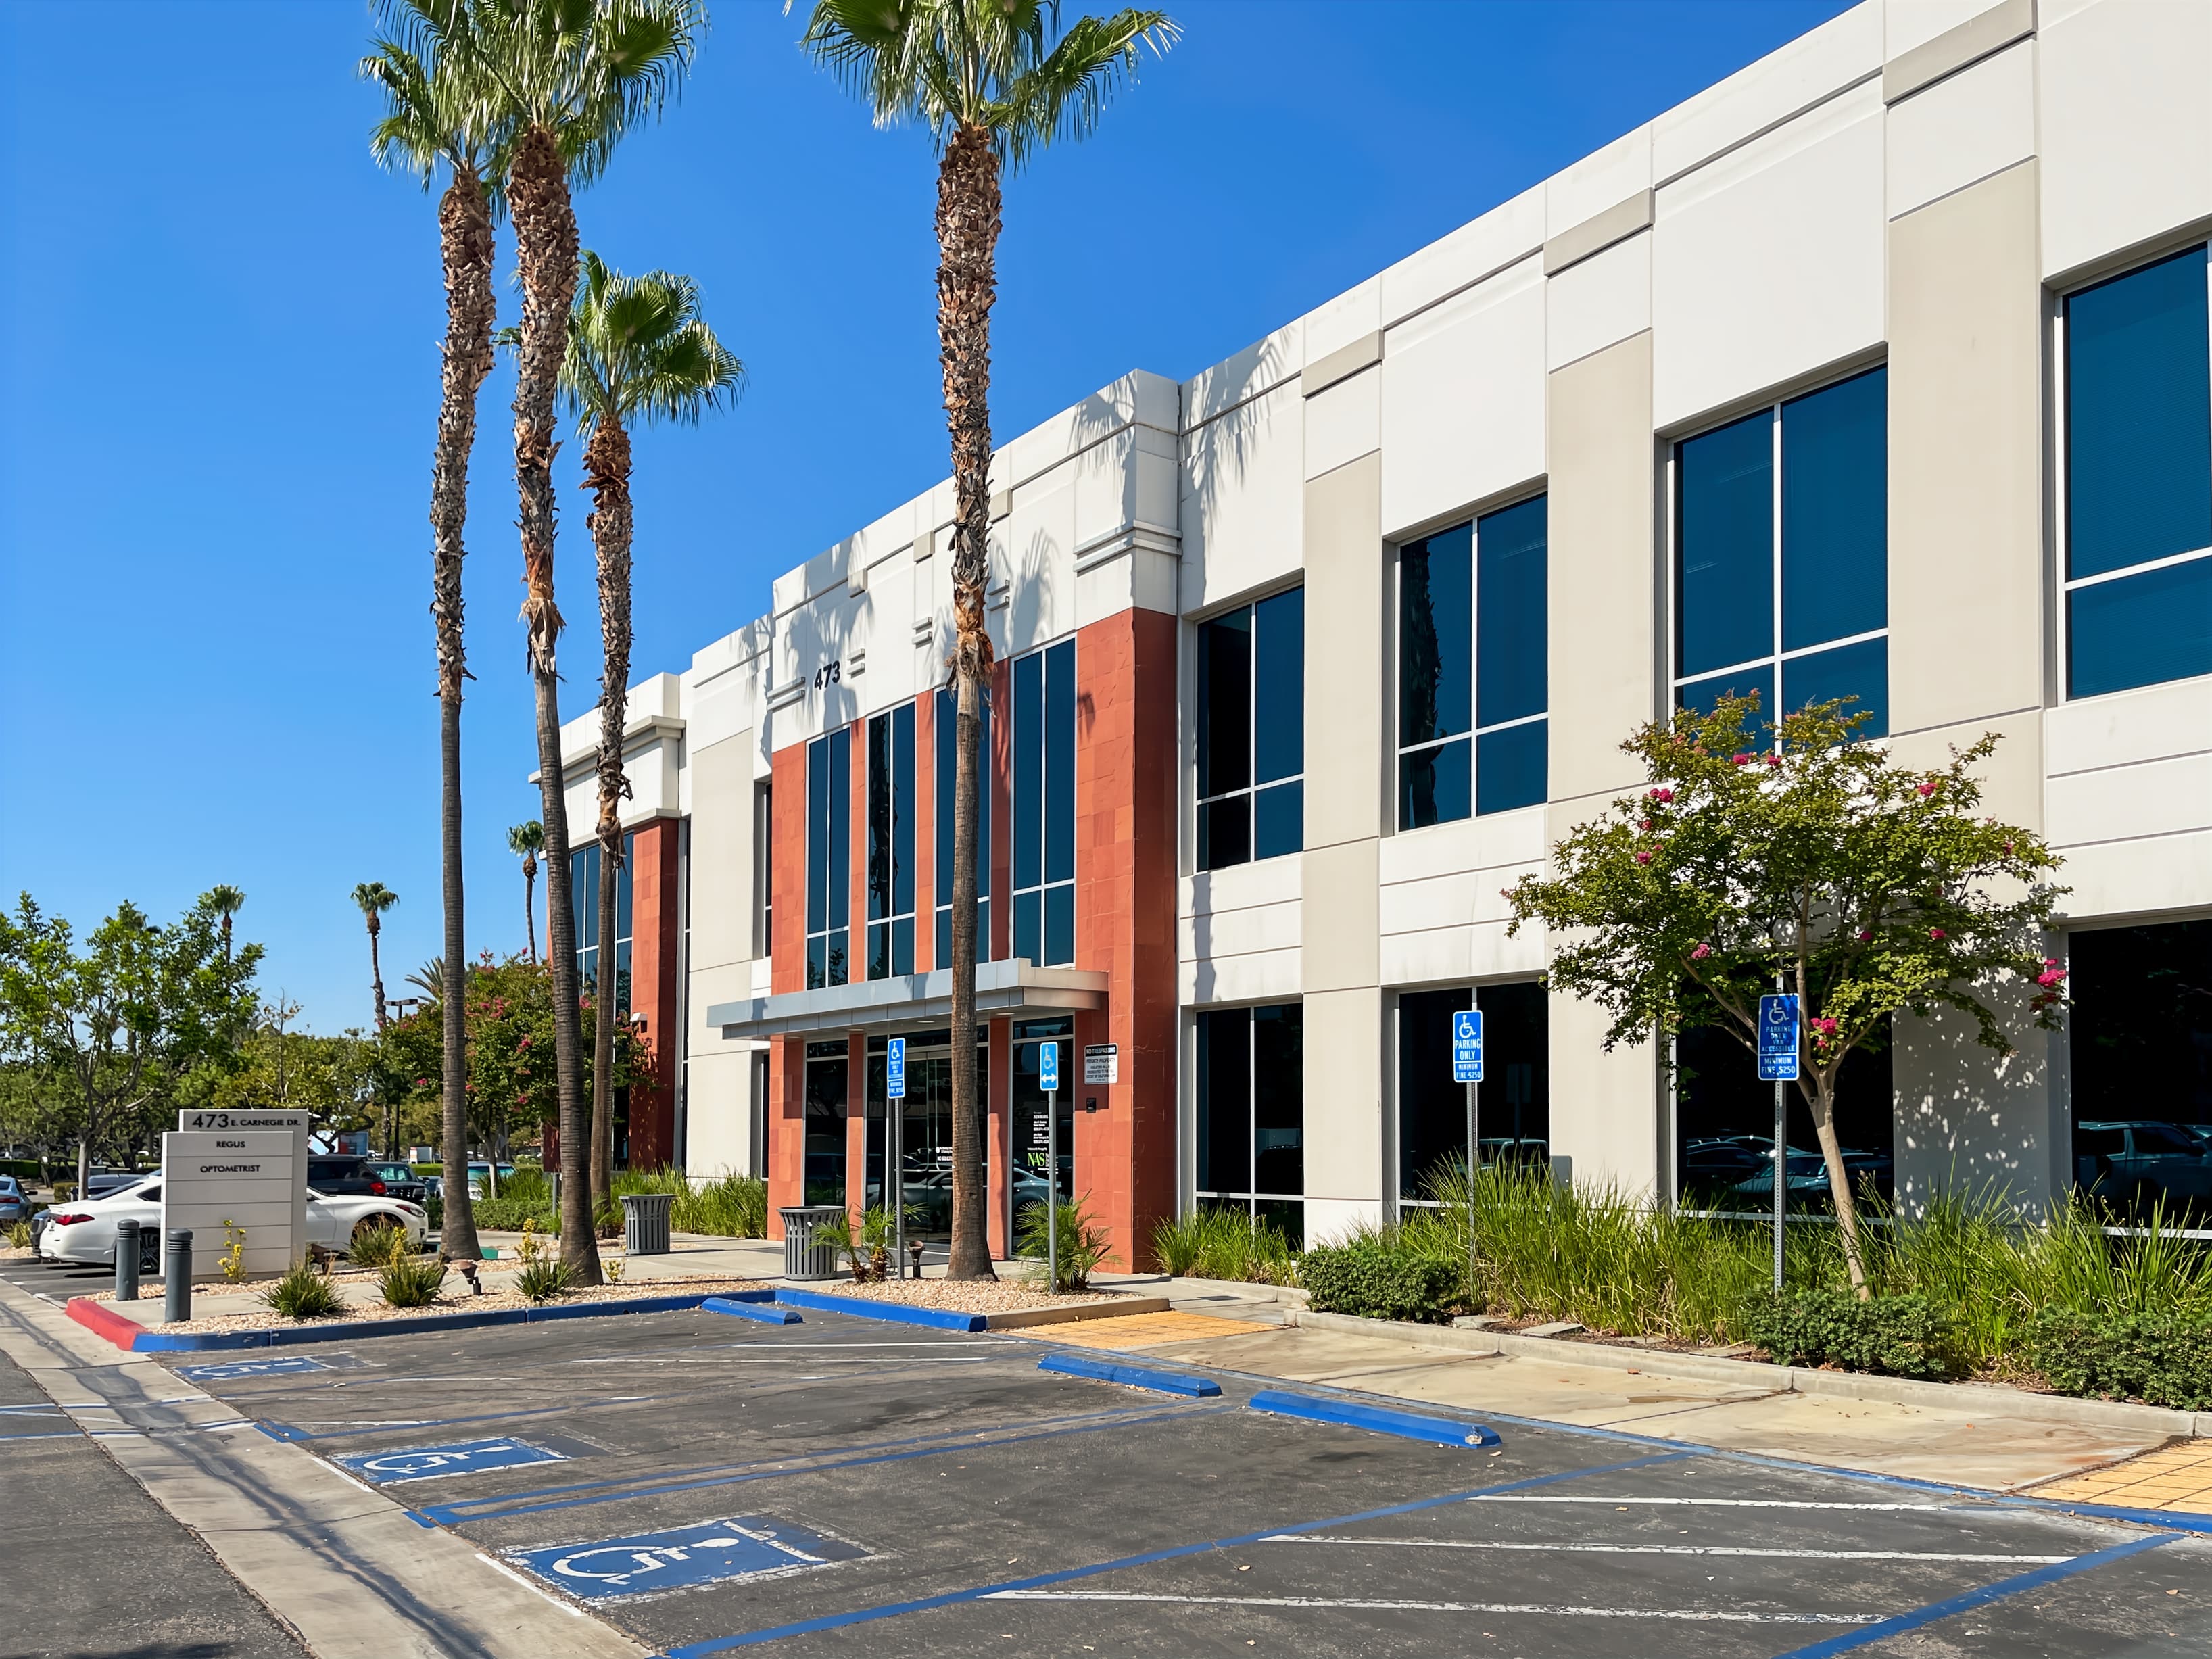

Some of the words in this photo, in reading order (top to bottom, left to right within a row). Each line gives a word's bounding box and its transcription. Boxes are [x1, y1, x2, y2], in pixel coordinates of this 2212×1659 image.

[815, 660, 840, 690] 473
[1455, 1038, 1481, 1049] PARKING
[1460, 1050, 1476, 1061] ONLY
[1764, 1057, 1792, 1065] MINIMUM
[1468, 1071, 1481, 1079] $250
[1761, 1066, 1776, 1074] FINE
[1778, 1065, 1796, 1074] $250
[192, 1114, 229, 1128] 473
[1028, 1152, 1045, 1167] NAS
[200, 1165, 260, 1173] OPTOMETRIST
